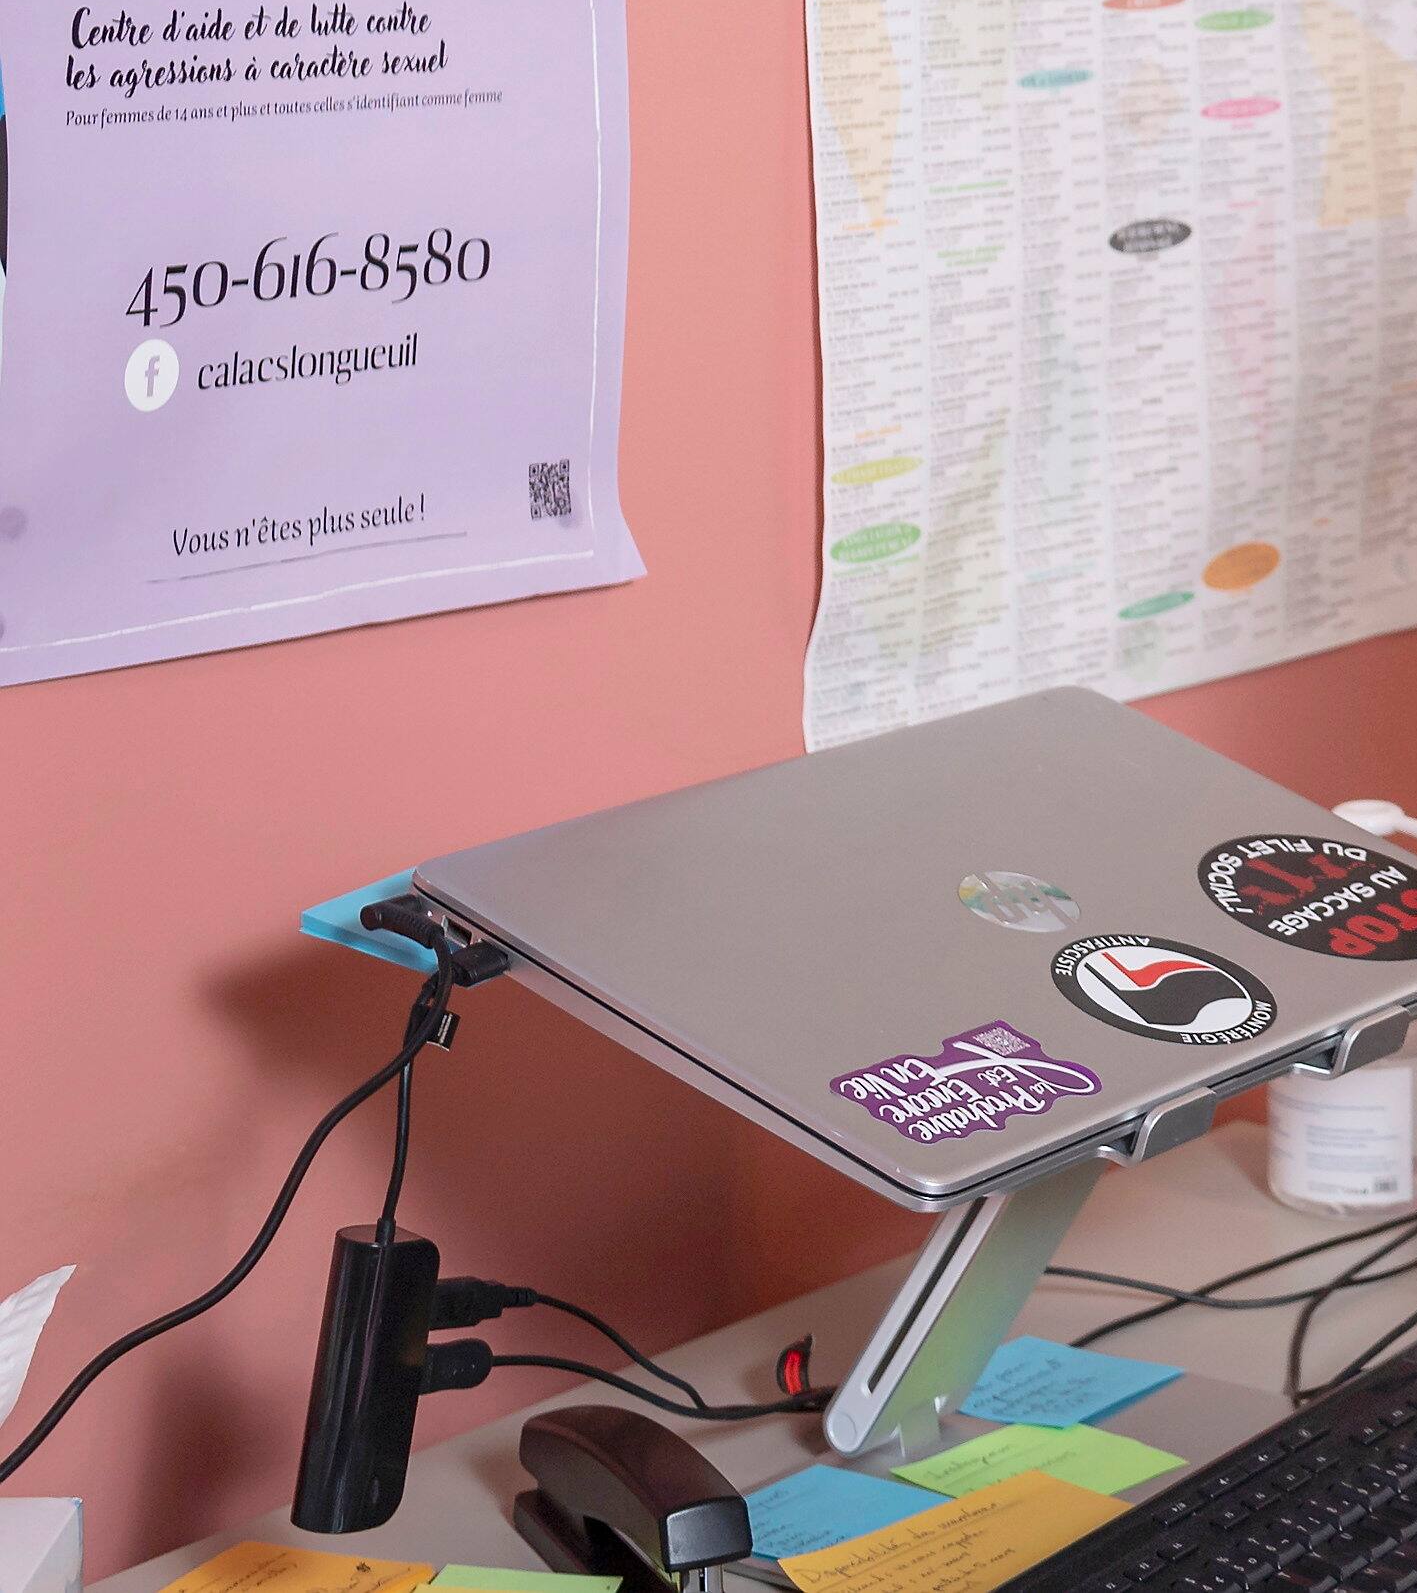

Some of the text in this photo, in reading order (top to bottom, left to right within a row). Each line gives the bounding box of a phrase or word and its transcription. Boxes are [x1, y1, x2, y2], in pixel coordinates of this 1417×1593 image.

[71, 1, 433, 49] Centre d'aide et de lutte contre
[65, 40, 449, 99] les agressions à caractère sexuel
[66, 110, 98, 127] Pour
[99, 105, 155, 130] femmes
[157, 107, 172, 123] de
[175, 108, 188, 122] 14
[190, 107, 215, 120] ans
[216, 104, 229, 118] et
[230, 101, 258, 122] plus
[259, 102, 272, 116] et
[273, 99, 312, 115] toutes
[313, 95, 345, 113] celles
[346, 91, 421, 113] s'identifiant
[421, 93, 464, 107] comme
[126, 228, 491, 328] 450-616-8580
[198, 334, 418, 392] calacslongueuil
[172, 526, 230, 558] Vous
[234, 517, 303, 549] n'êtes
[308, 506, 356, 546] plus
[359, 499, 415, 532] seule
[1237, 838, 1368, 862] FILET DU
[1207, 852, 1254, 914] SOCIAL!
[1267, 865, 1408, 936] AU SACCAGE
[1055, 935, 1152, 976] ANTIFASCISTE
[1180, 1000, 1272, 1044] MONTÉRÉGIE
[840, 1058, 947, 1099] En Vie
[978, 1066, 1018, 1086] Est
[879, 1079, 983, 1123] Encore
[909, 1086, 1045, 1141] Prochaine
